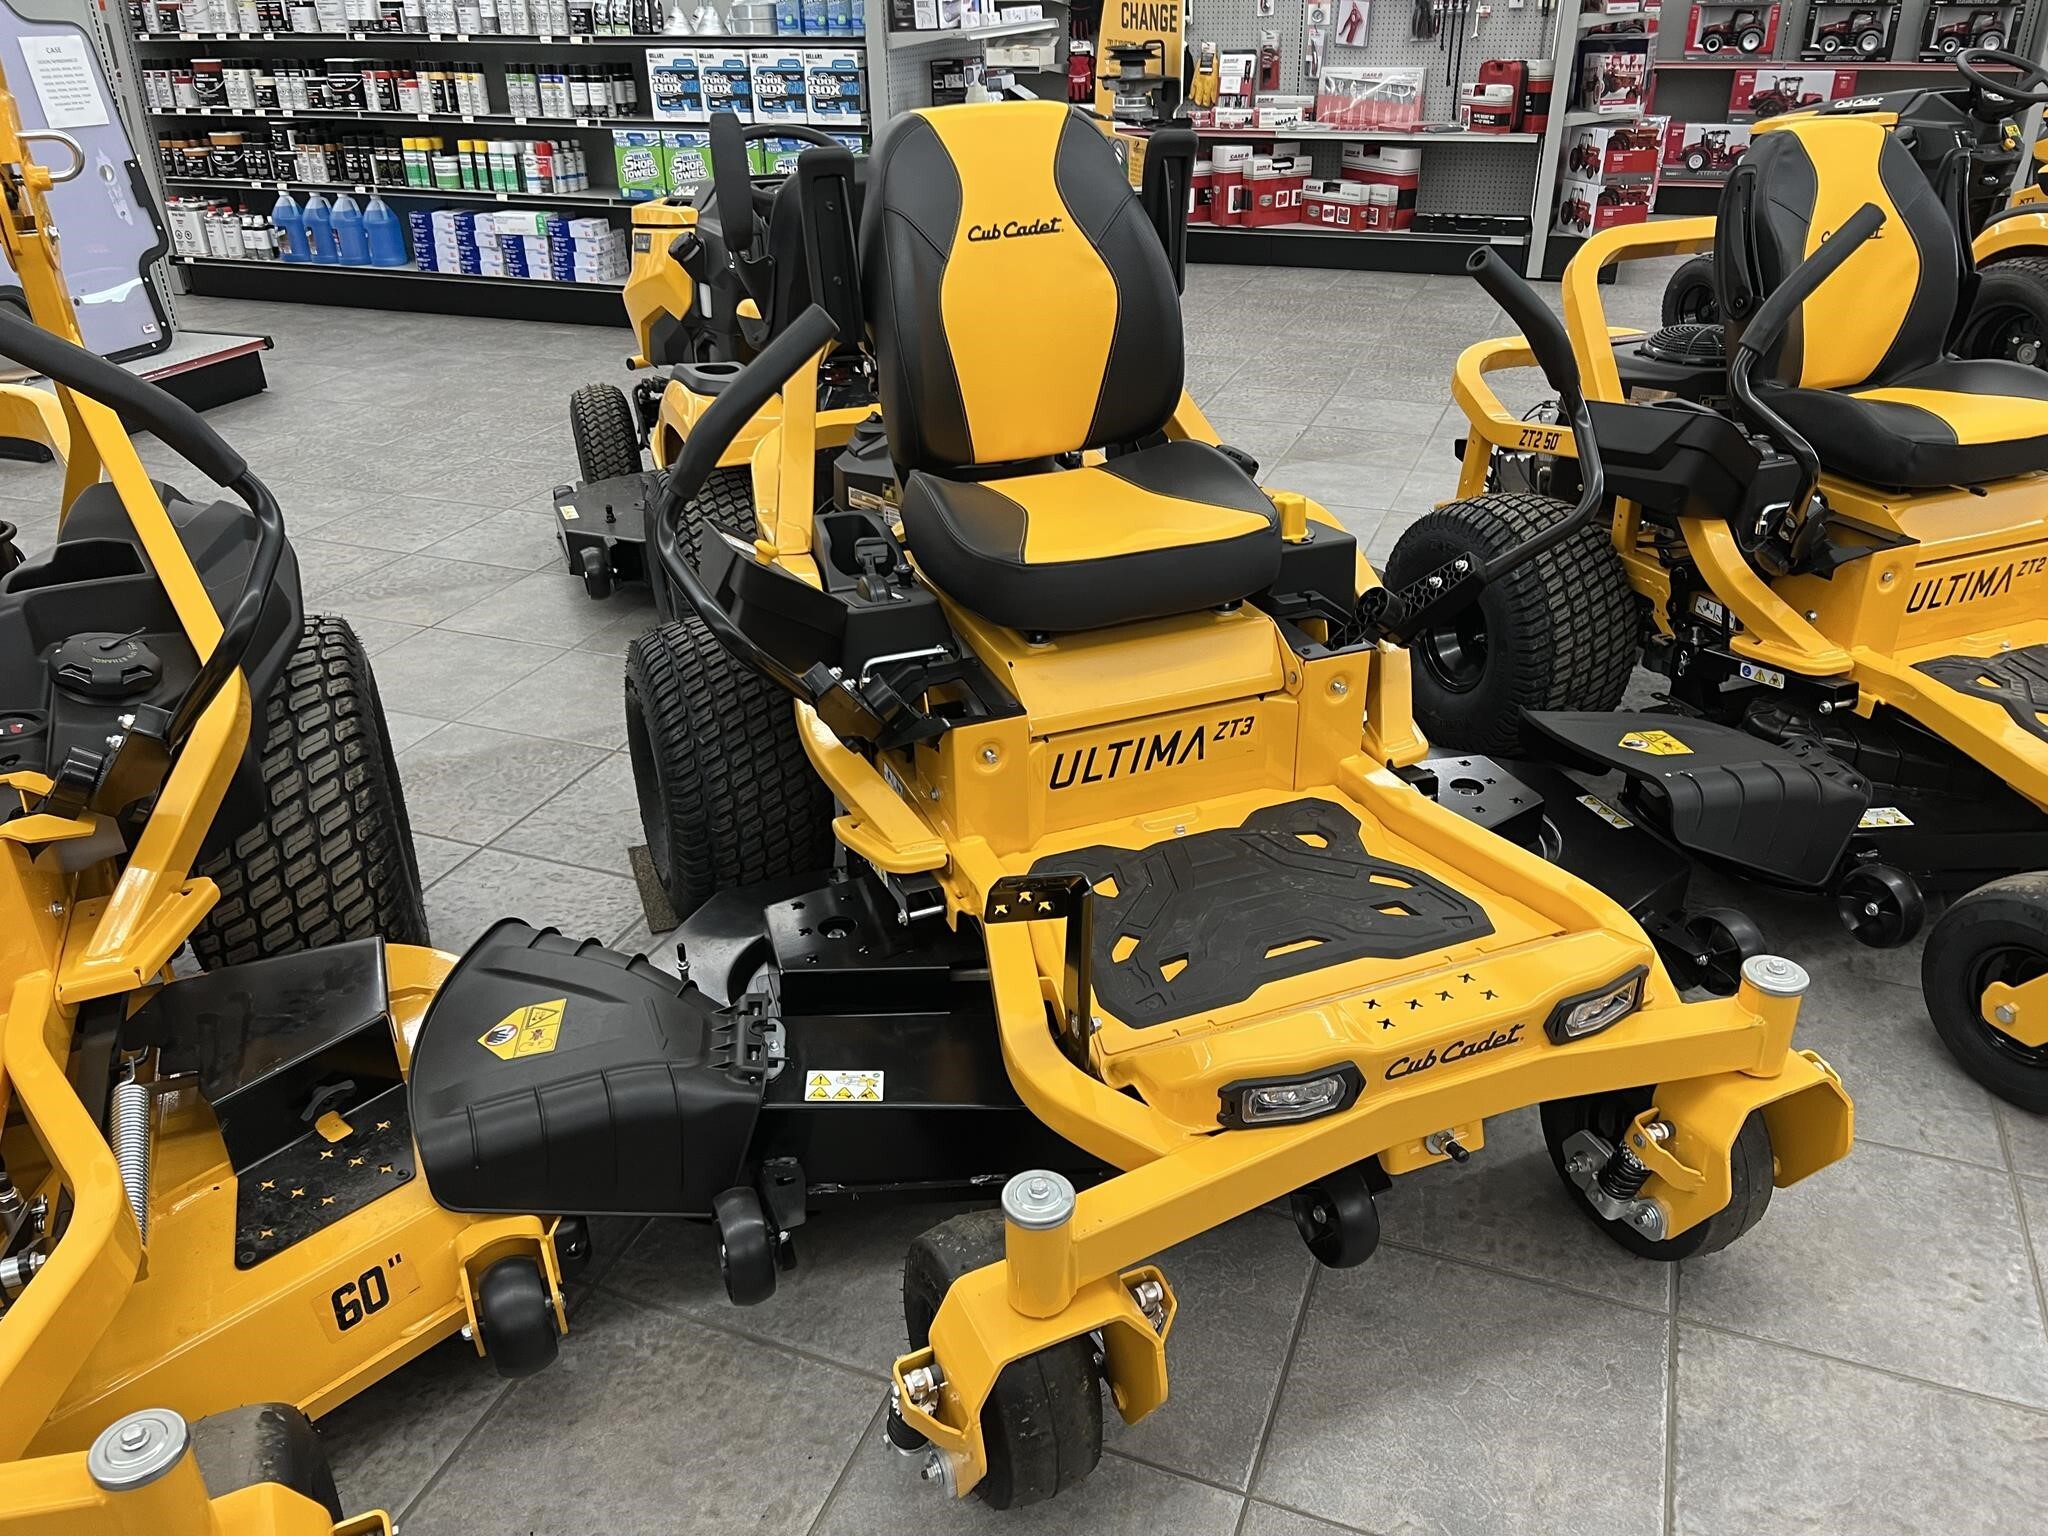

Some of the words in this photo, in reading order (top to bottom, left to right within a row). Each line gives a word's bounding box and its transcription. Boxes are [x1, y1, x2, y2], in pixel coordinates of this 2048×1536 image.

[1121, 2, 1178, 33] CHANGE
[652, 72, 682, 84] TOOL
[702, 73, 732, 85] TOOL
[753, 72, 786, 85] TOOL
[807, 73, 840, 85] TOOL
[653, 83, 683, 94] BOX
[703, 84, 732, 95] BOX
[755, 84, 787, 95] BOX
[809, 84, 841, 96] BOX
[625, 156, 654, 170] SHOP
[682, 153, 701, 161] BLUE
[674, 158, 703, 172] SHOP
[623, 167, 658, 182] TOWELS
[672, 167, 708, 184] TOWELS
[967, 223, 1002, 242] Cub
[1003, 217, 1063, 239] Cadet
[1518, 429, 1543, 448] ZT2
[1905, 563, 2015, 614] ULTIMA
[2016, 556, 2048, 577] ZT2
[1049, 725, 1205, 791] ULTIMA
[1212, 715, 1256, 742] ZT3
[1384, 1049, 1437, 1081] Cub
[1439, 1023, 1527, 1064] Cadet
[331, 1253, 402, 1332] 60"
